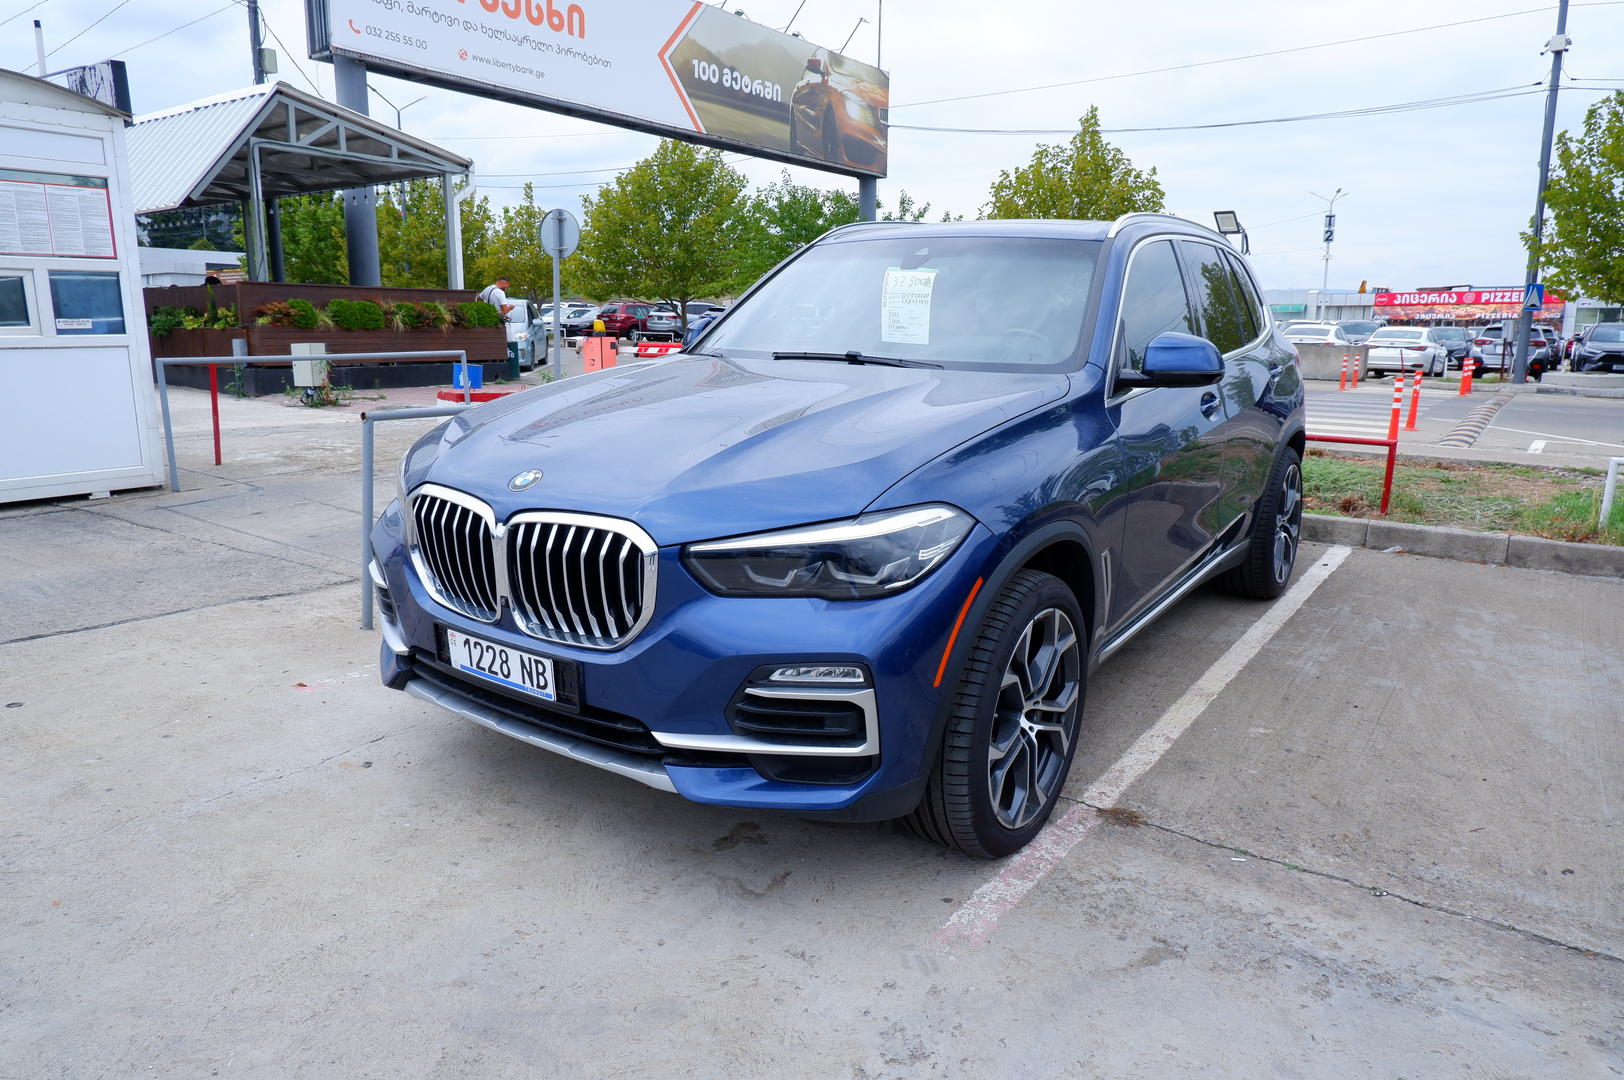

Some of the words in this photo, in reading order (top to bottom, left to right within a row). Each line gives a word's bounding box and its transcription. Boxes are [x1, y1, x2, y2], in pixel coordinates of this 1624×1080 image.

[365, 25, 383, 38] 032
[385, 30, 401, 43] 255
[402, 35, 414, 47] 55
[415, 38, 428, 50] 00
[406, 1, 460, 27] მარტივი
[462, 20, 479, 32] და
[480, 22, 554, 52] ხელსაყრელი
[556, 43, 612, 69] პირობებით
[471, 53, 546, 80] www.libertybank.ge
[692, 59, 720, 84] 100
[722, 67, 782, 102] მეტრში
[1325, 214, 1336, 227] T
[1324, 230, 1333, 242] 2
[1393, 293, 1457, 305] პიცერია
[463, 637, 511, 679] 1228
[519, 654, 548, 690] NB
